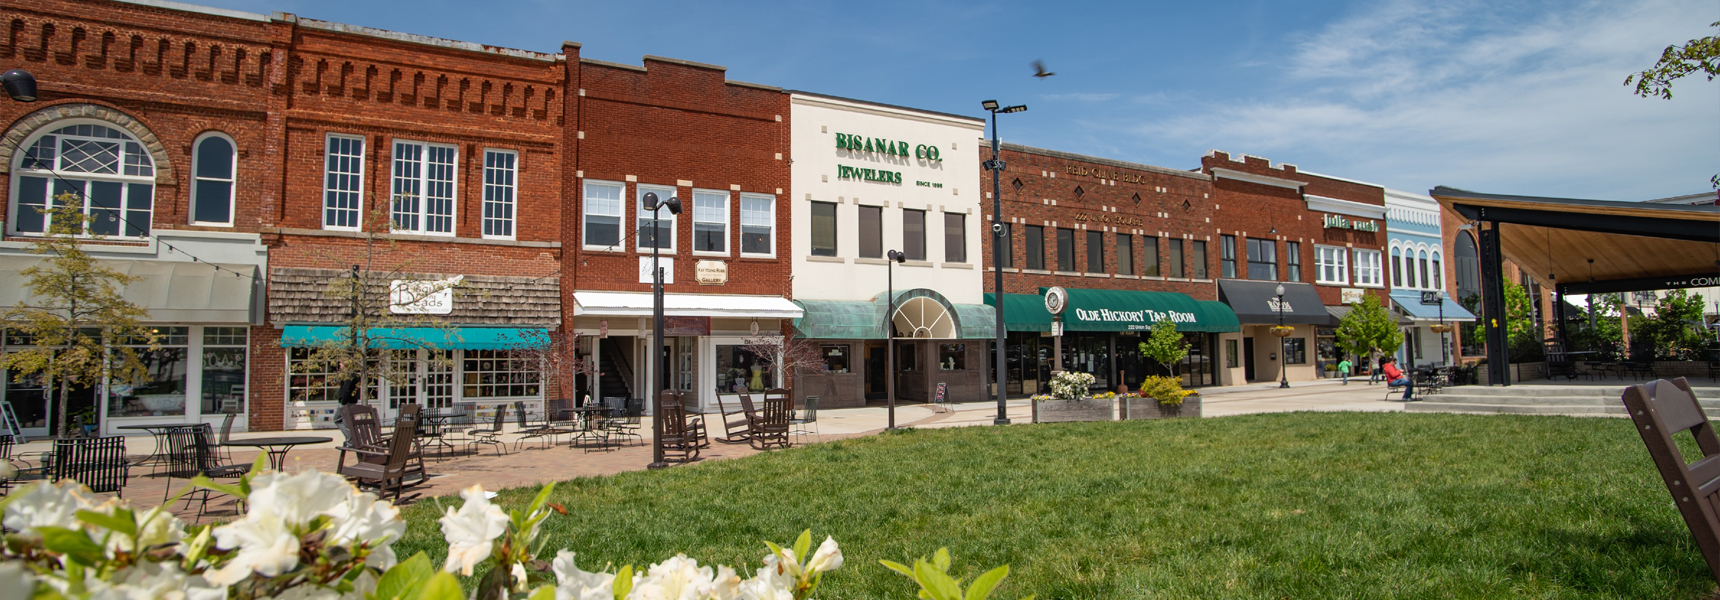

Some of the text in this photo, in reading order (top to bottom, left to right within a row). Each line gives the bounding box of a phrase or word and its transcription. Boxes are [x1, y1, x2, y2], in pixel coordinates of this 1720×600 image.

[836, 132, 943, 162] BISANAR CO.
[837, 164, 902, 184] JEWELERS
[916, 180, 931, 188] SINCE
[1115, 215, 1144, 227] SQUARE
[1353, 219, 1380, 232] rush
[1075, 308, 1197, 323] OLDE HICKORY TAP ROOM
